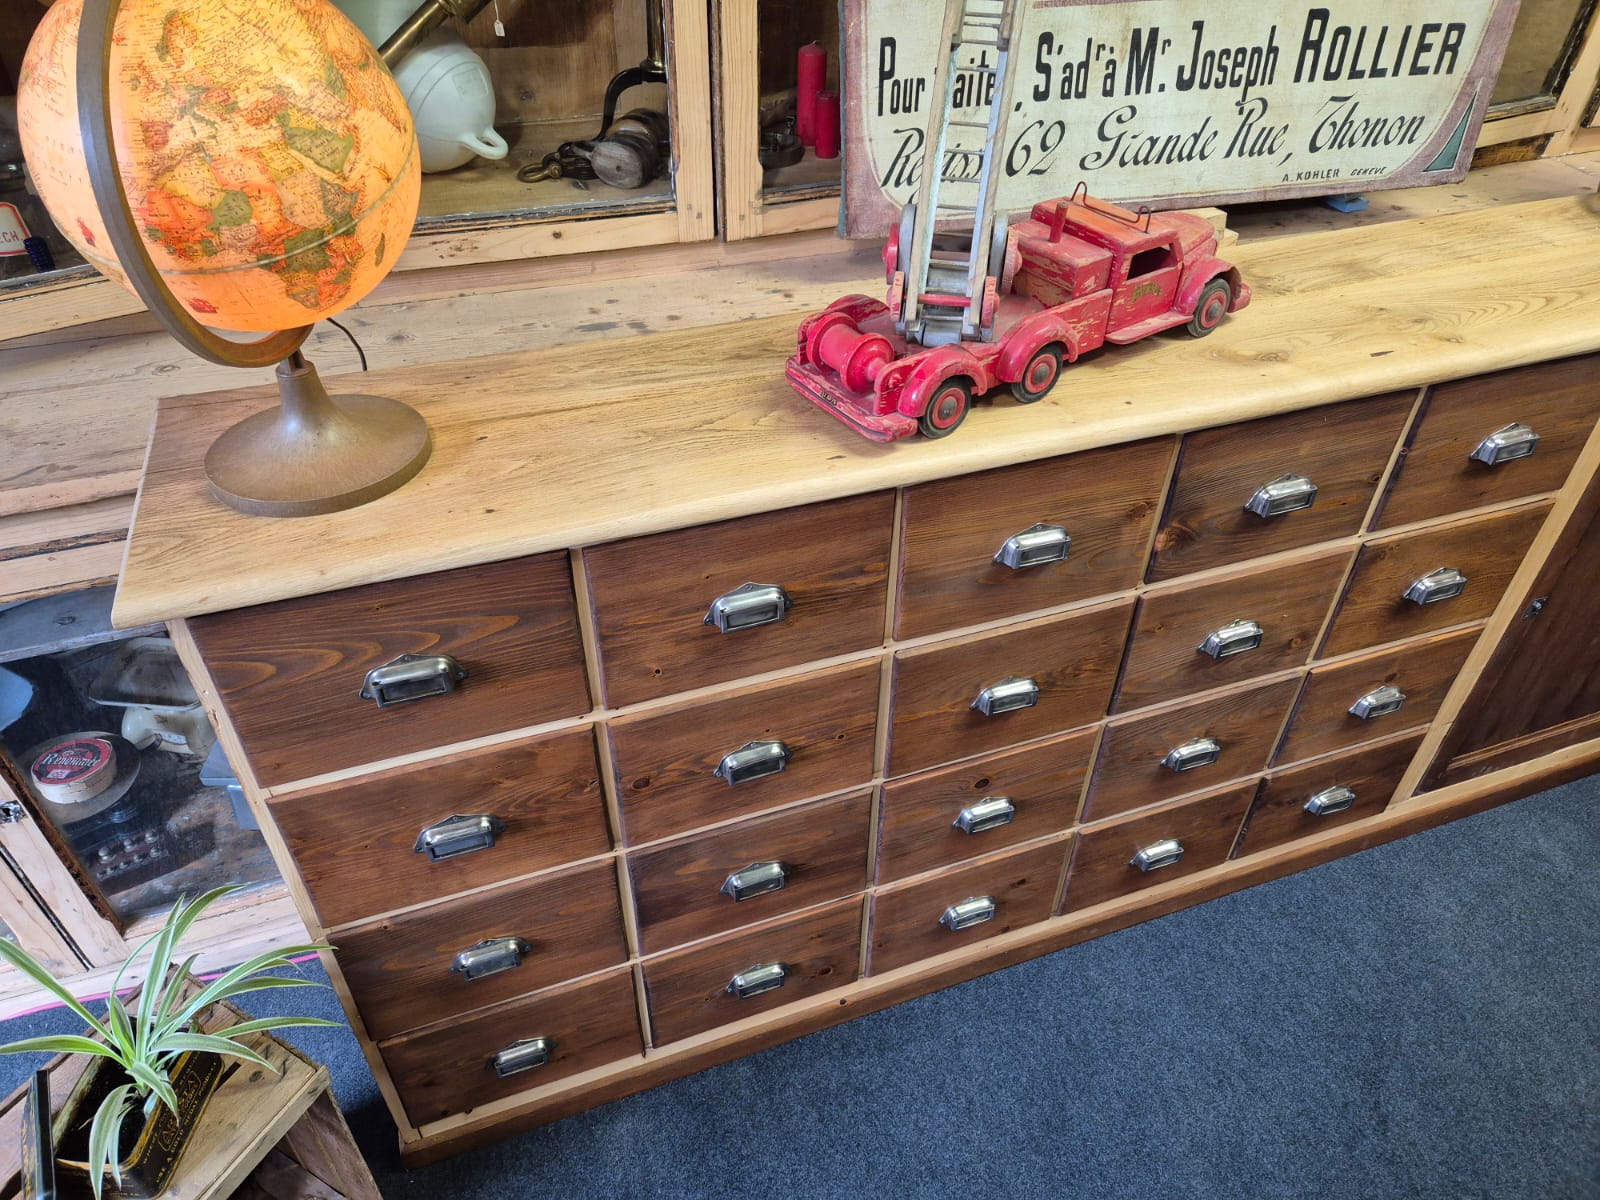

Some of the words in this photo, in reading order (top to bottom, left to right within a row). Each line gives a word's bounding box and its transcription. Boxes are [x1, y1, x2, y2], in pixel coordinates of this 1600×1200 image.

[877, 36, 926, 116] Pour
[1176, 20, 1280, 114] Joseph
[1294, 8, 1467, 83] ROLLIER
[1005, 119, 1066, 177] 62
[1223, 97, 1294, 166] Rue,
[1309, 91, 1426, 154] Thonon
